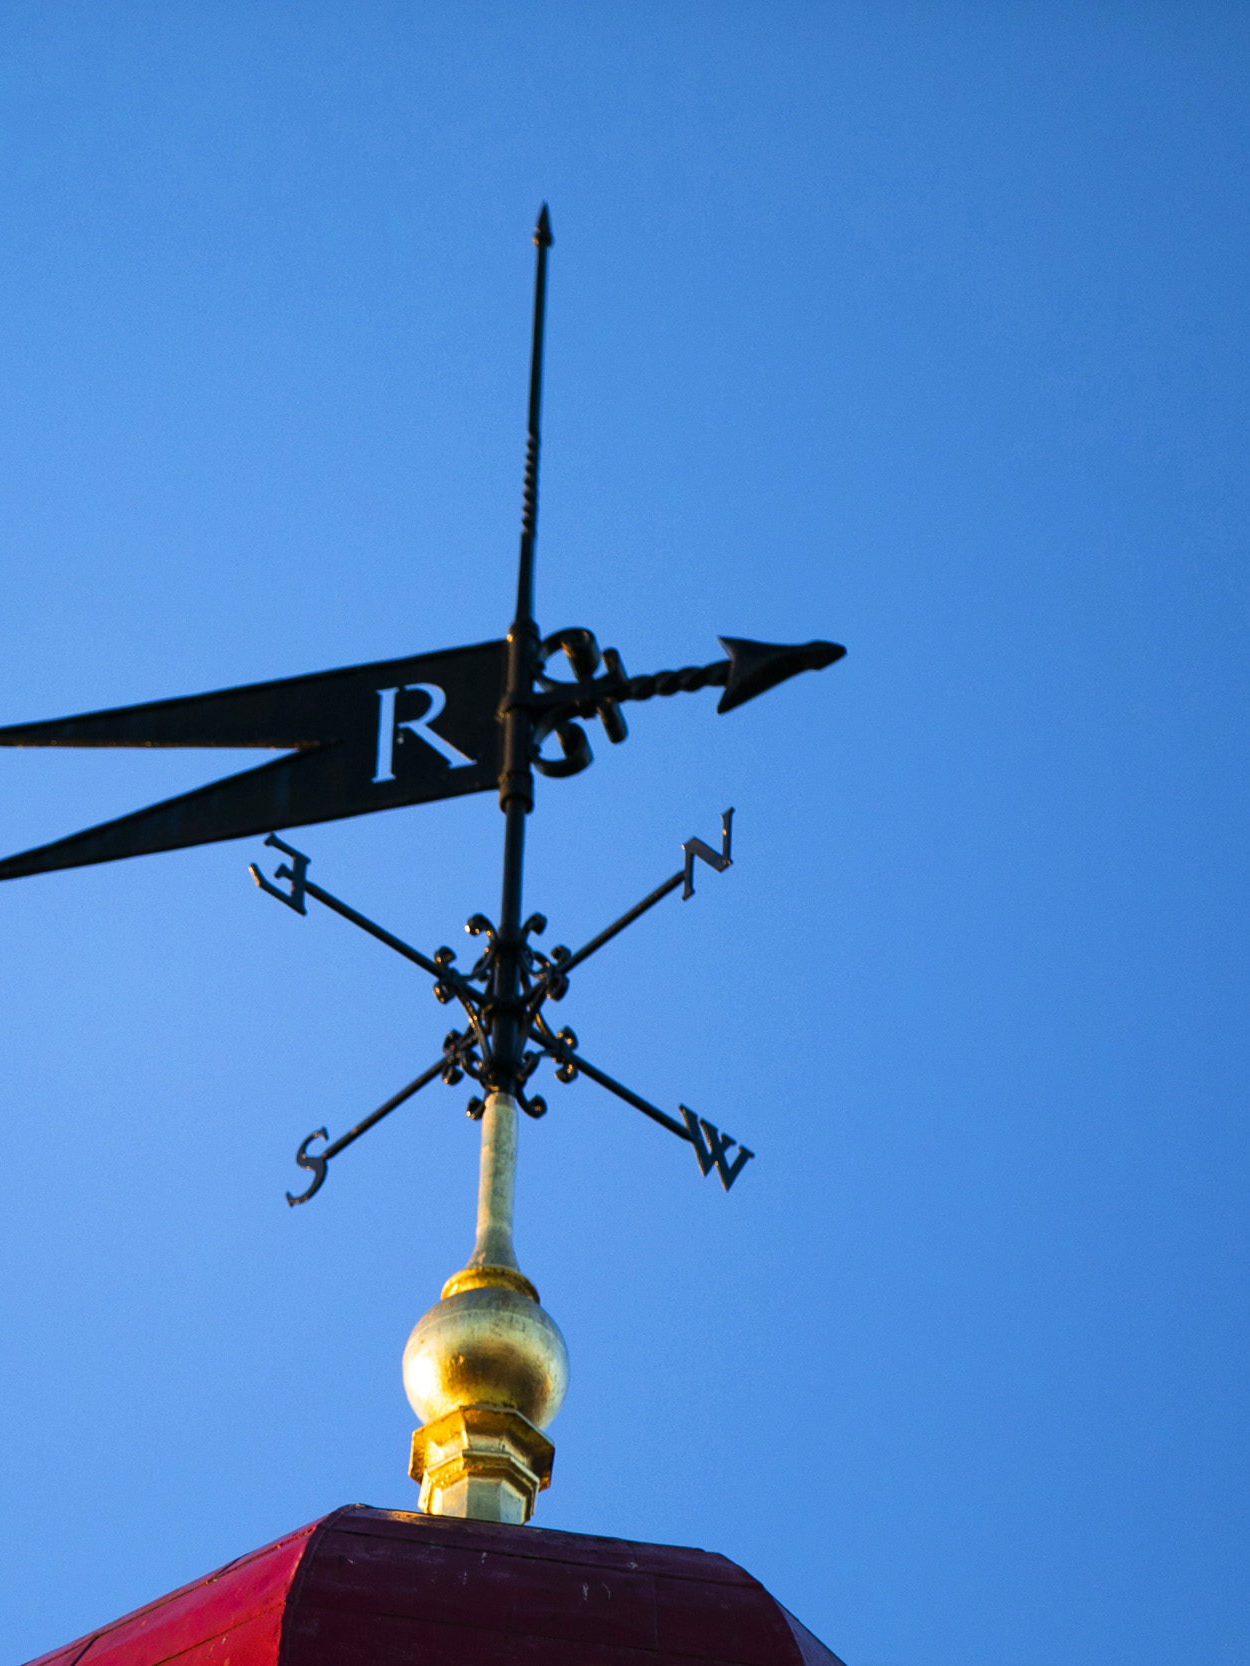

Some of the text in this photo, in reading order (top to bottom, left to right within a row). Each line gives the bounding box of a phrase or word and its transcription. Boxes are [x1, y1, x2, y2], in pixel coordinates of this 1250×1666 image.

[371, 682, 478, 784] R
[681, 806, 735, 902] N
[285, 1125, 329, 1208] S
[678, 1103, 755, 1192] W
